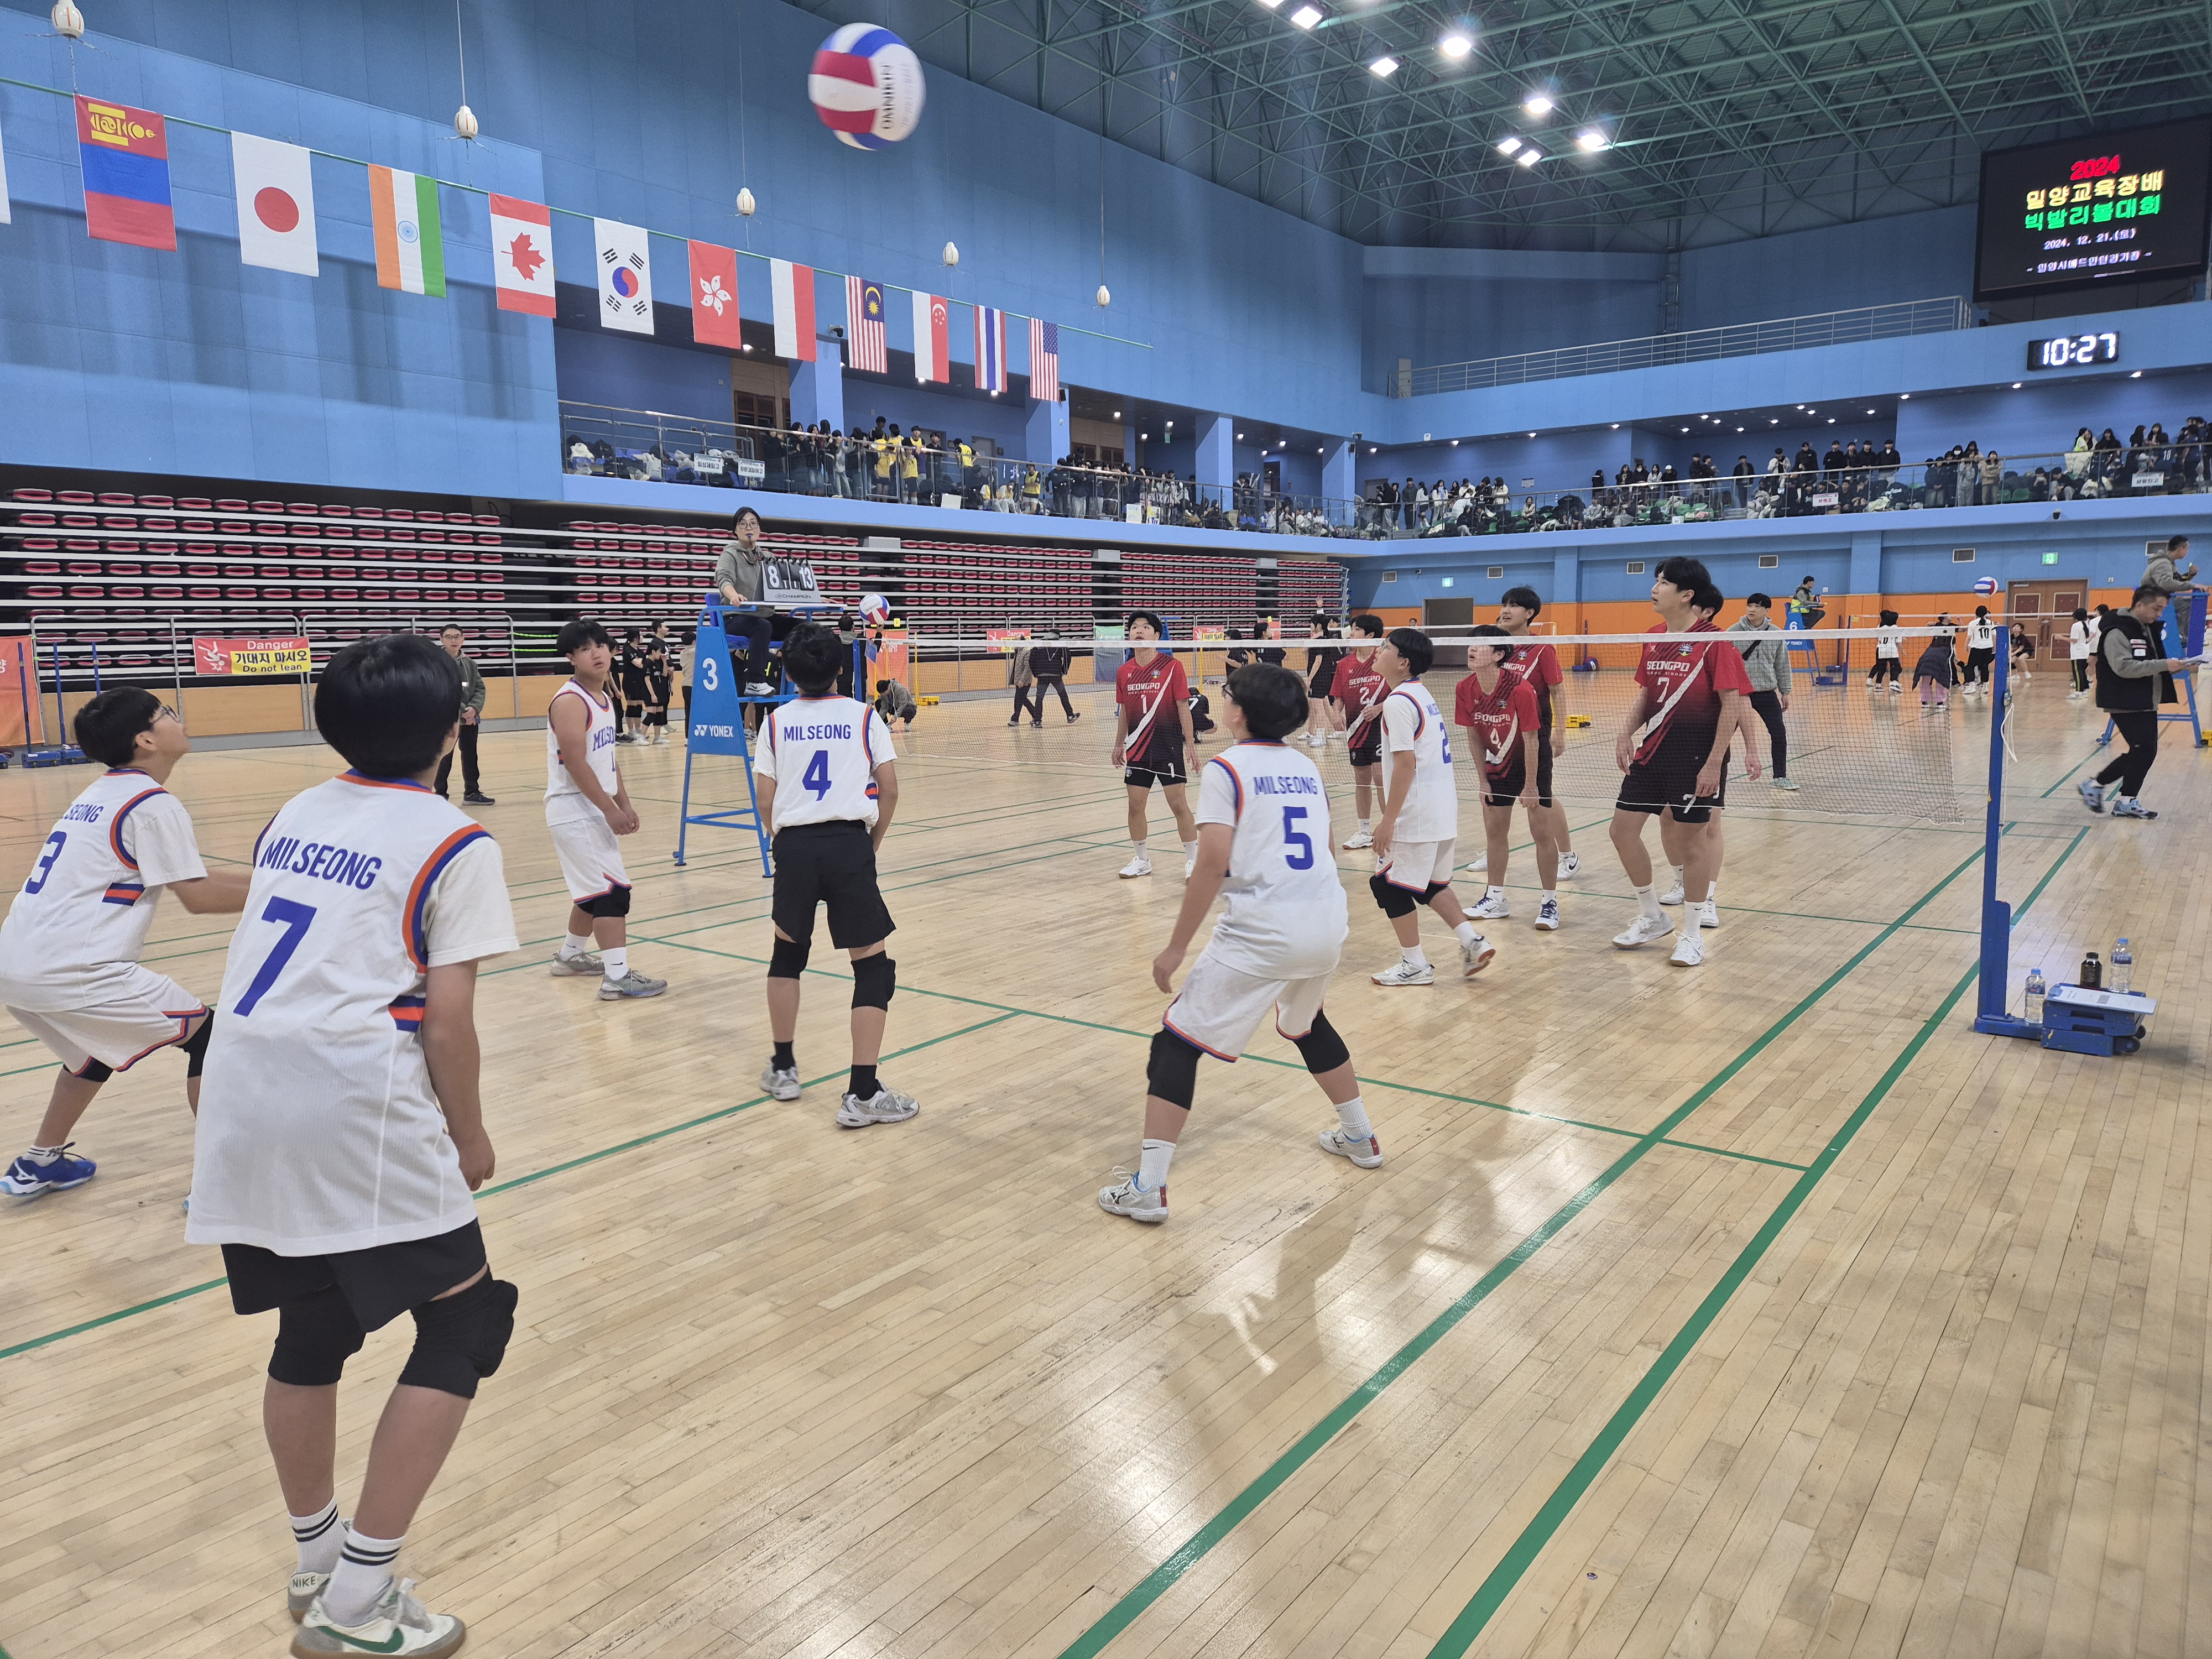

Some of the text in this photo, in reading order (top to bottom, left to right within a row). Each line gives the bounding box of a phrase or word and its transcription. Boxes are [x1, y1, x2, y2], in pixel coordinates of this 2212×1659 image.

[2070, 155, 2120, 180] 2024
[2026, 170, 2164, 210] 밀양교육장배
[2025, 194, 2161, 231] 빅발리볼대회
[2043, 238, 2071, 250] 2024.
[2077, 235, 2091, 246] 12.
[2042, 333, 2116, 366] 10:27
[768, 565, 780, 588] 8
[799, 567, 813, 589] 13
[1790, 621, 1797, 630] 6
[1978, 628, 1989, 639] 10
[247, 641, 294, 650] Danger
[235, 650, 307, 664] 기대지 마시오
[1501, 662, 1526, 671] ONGPO
[1647, 661, 1690, 671] SEONGPO
[702, 658, 718, 691] 3
[1360, 687, 1370, 705] 2
[1657, 677, 1670, 703] 7
[1141, 695, 1147, 713] 1
[709, 725, 733, 737] YONEX
[784, 724, 851, 742] MILSEONG
[802, 750, 832, 801] 4
[1253, 776, 1317, 795] MILSEONG
[64, 804, 104, 823] SEONG
[1283, 806, 1314, 870] 5
[25, 831, 67, 894] 3
[259, 836, 383, 890] MILSEONG
[233, 895, 317, 1017] 7
[293, 1575, 316, 1588] NIKE
